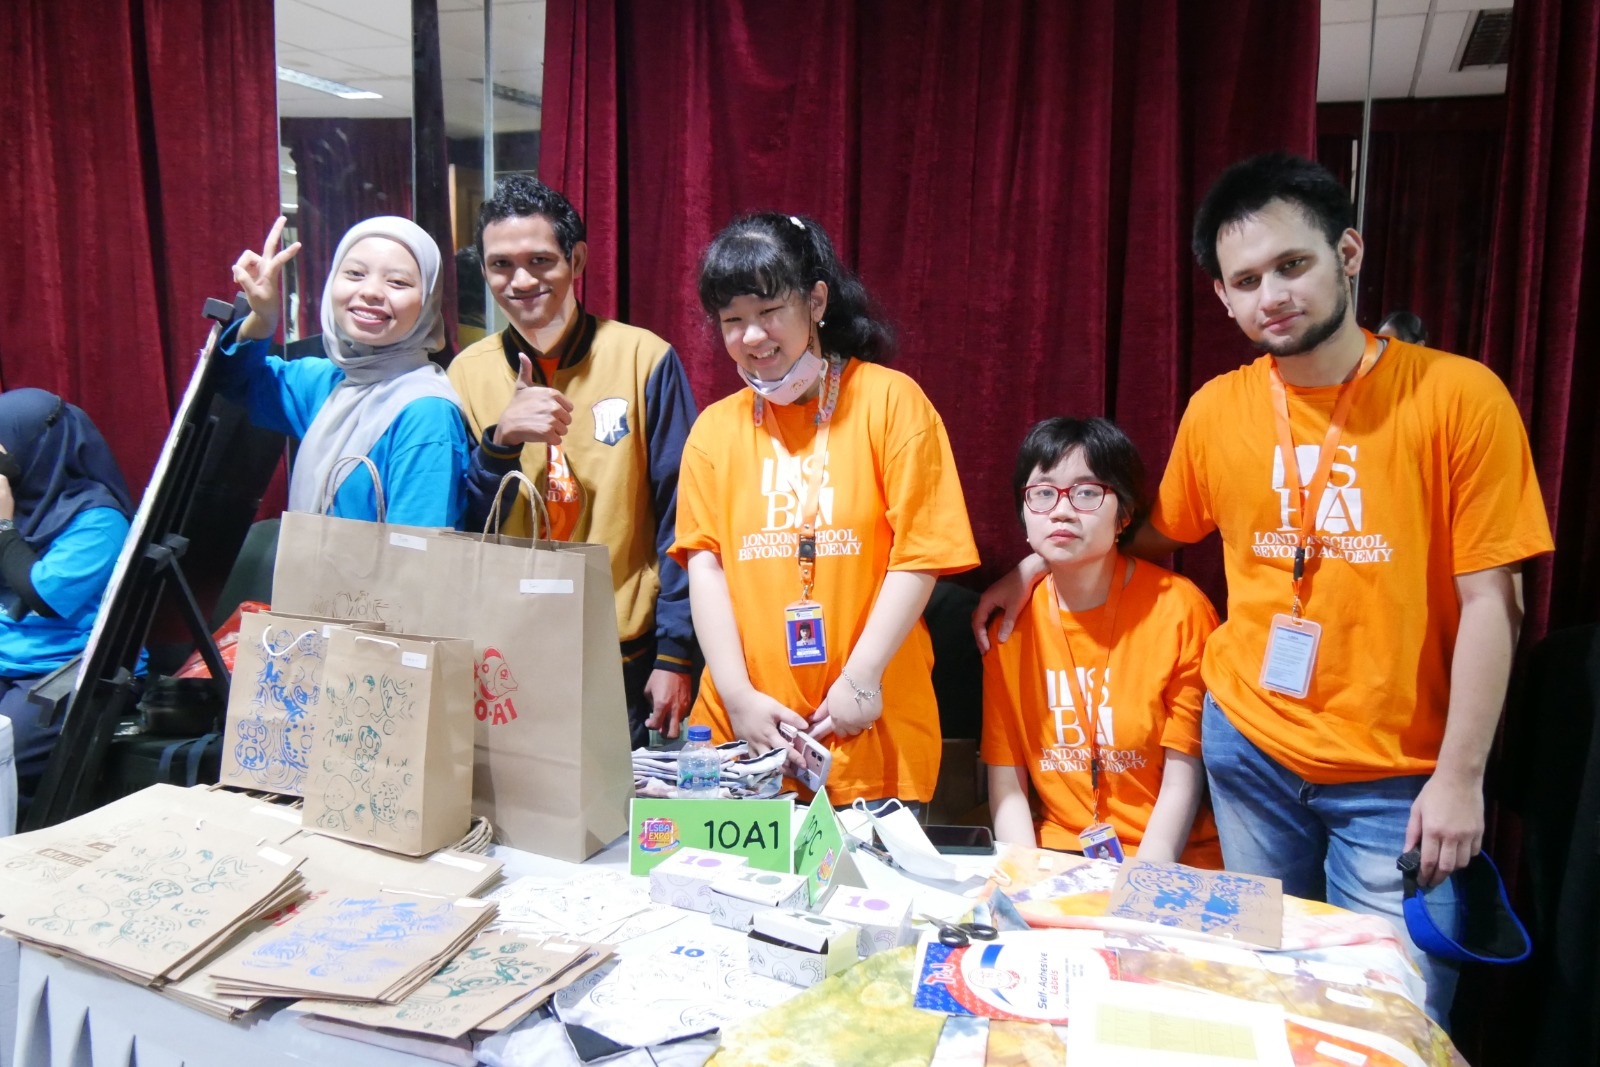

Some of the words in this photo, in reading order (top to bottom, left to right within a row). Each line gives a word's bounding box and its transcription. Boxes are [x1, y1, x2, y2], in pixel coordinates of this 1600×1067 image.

[742, 531, 797, 547] LONDON
[738, 544, 792, 561] BEYOND
[648, 823, 670, 832] LSBA
[704, 820, 779, 849] 10A1
[648, 832, 670, 840] EXPO
[1049, 969, 1059, 996] Labels
